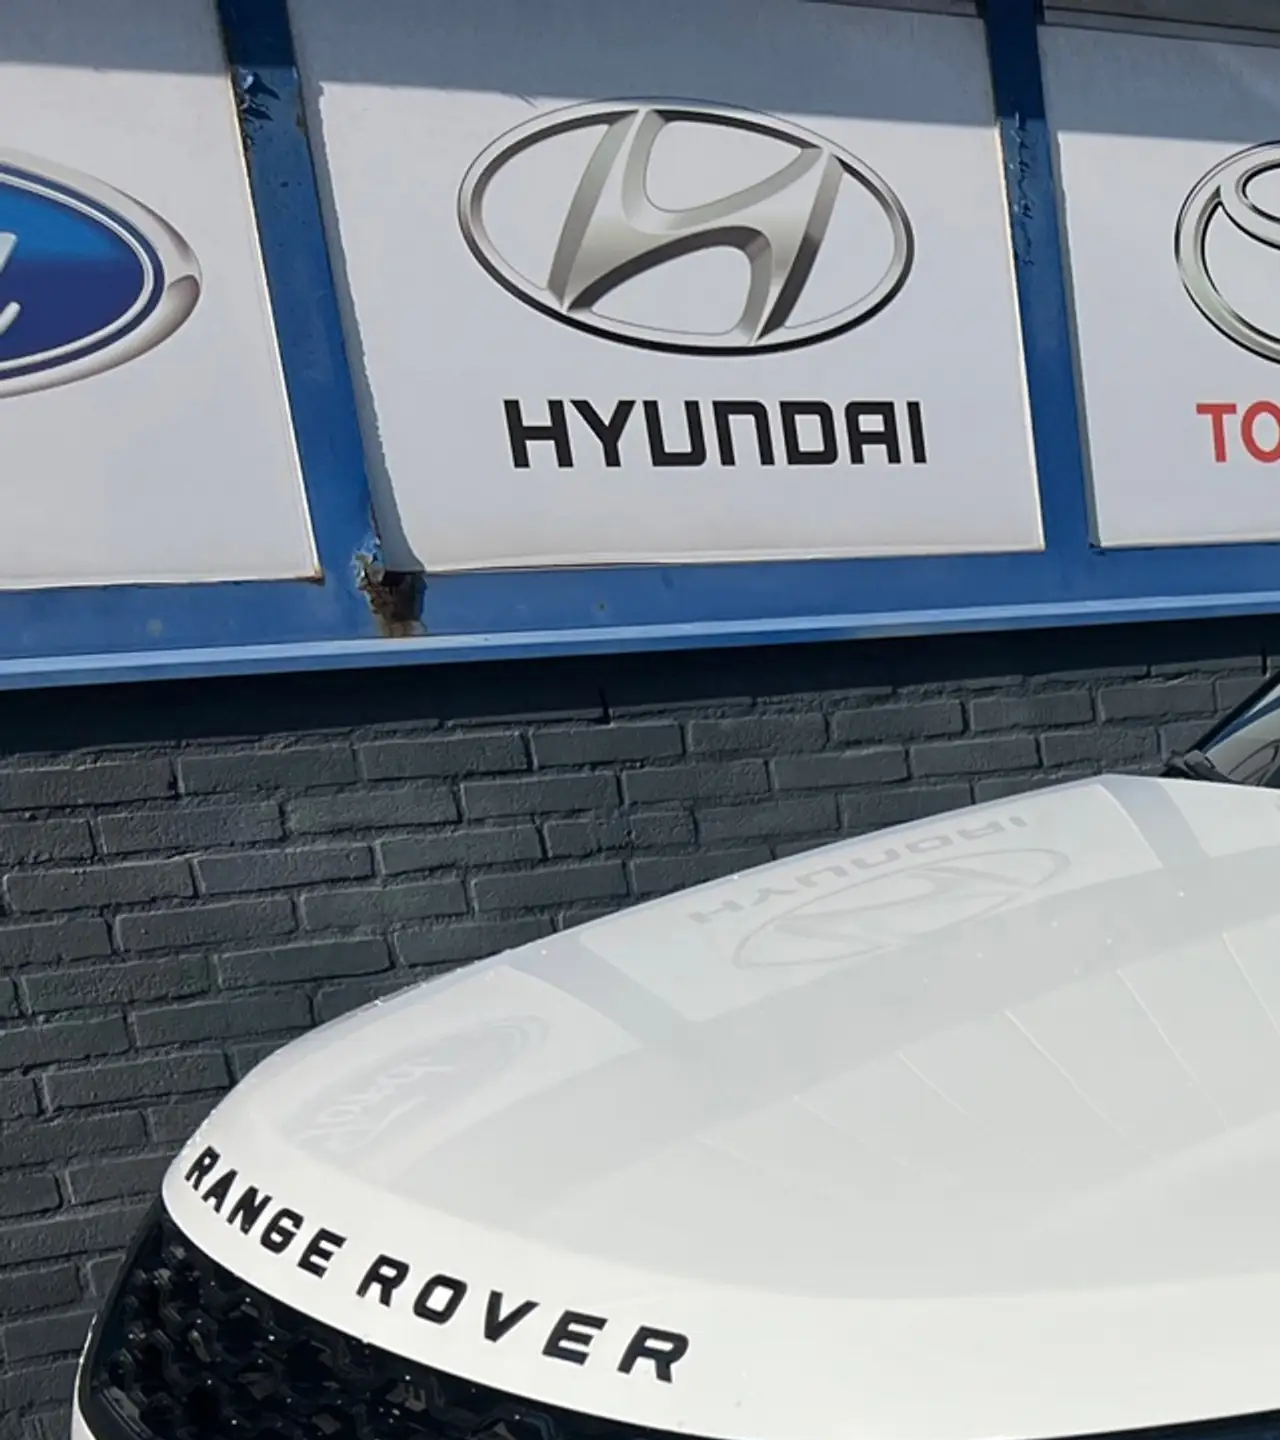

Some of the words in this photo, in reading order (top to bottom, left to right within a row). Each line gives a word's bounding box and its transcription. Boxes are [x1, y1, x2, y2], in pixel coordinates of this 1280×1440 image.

[504, 400, 926, 468] HYUNDAI
[186, 1147, 345, 1277] RANGE
[357, 1255, 689, 1381] ROVER
